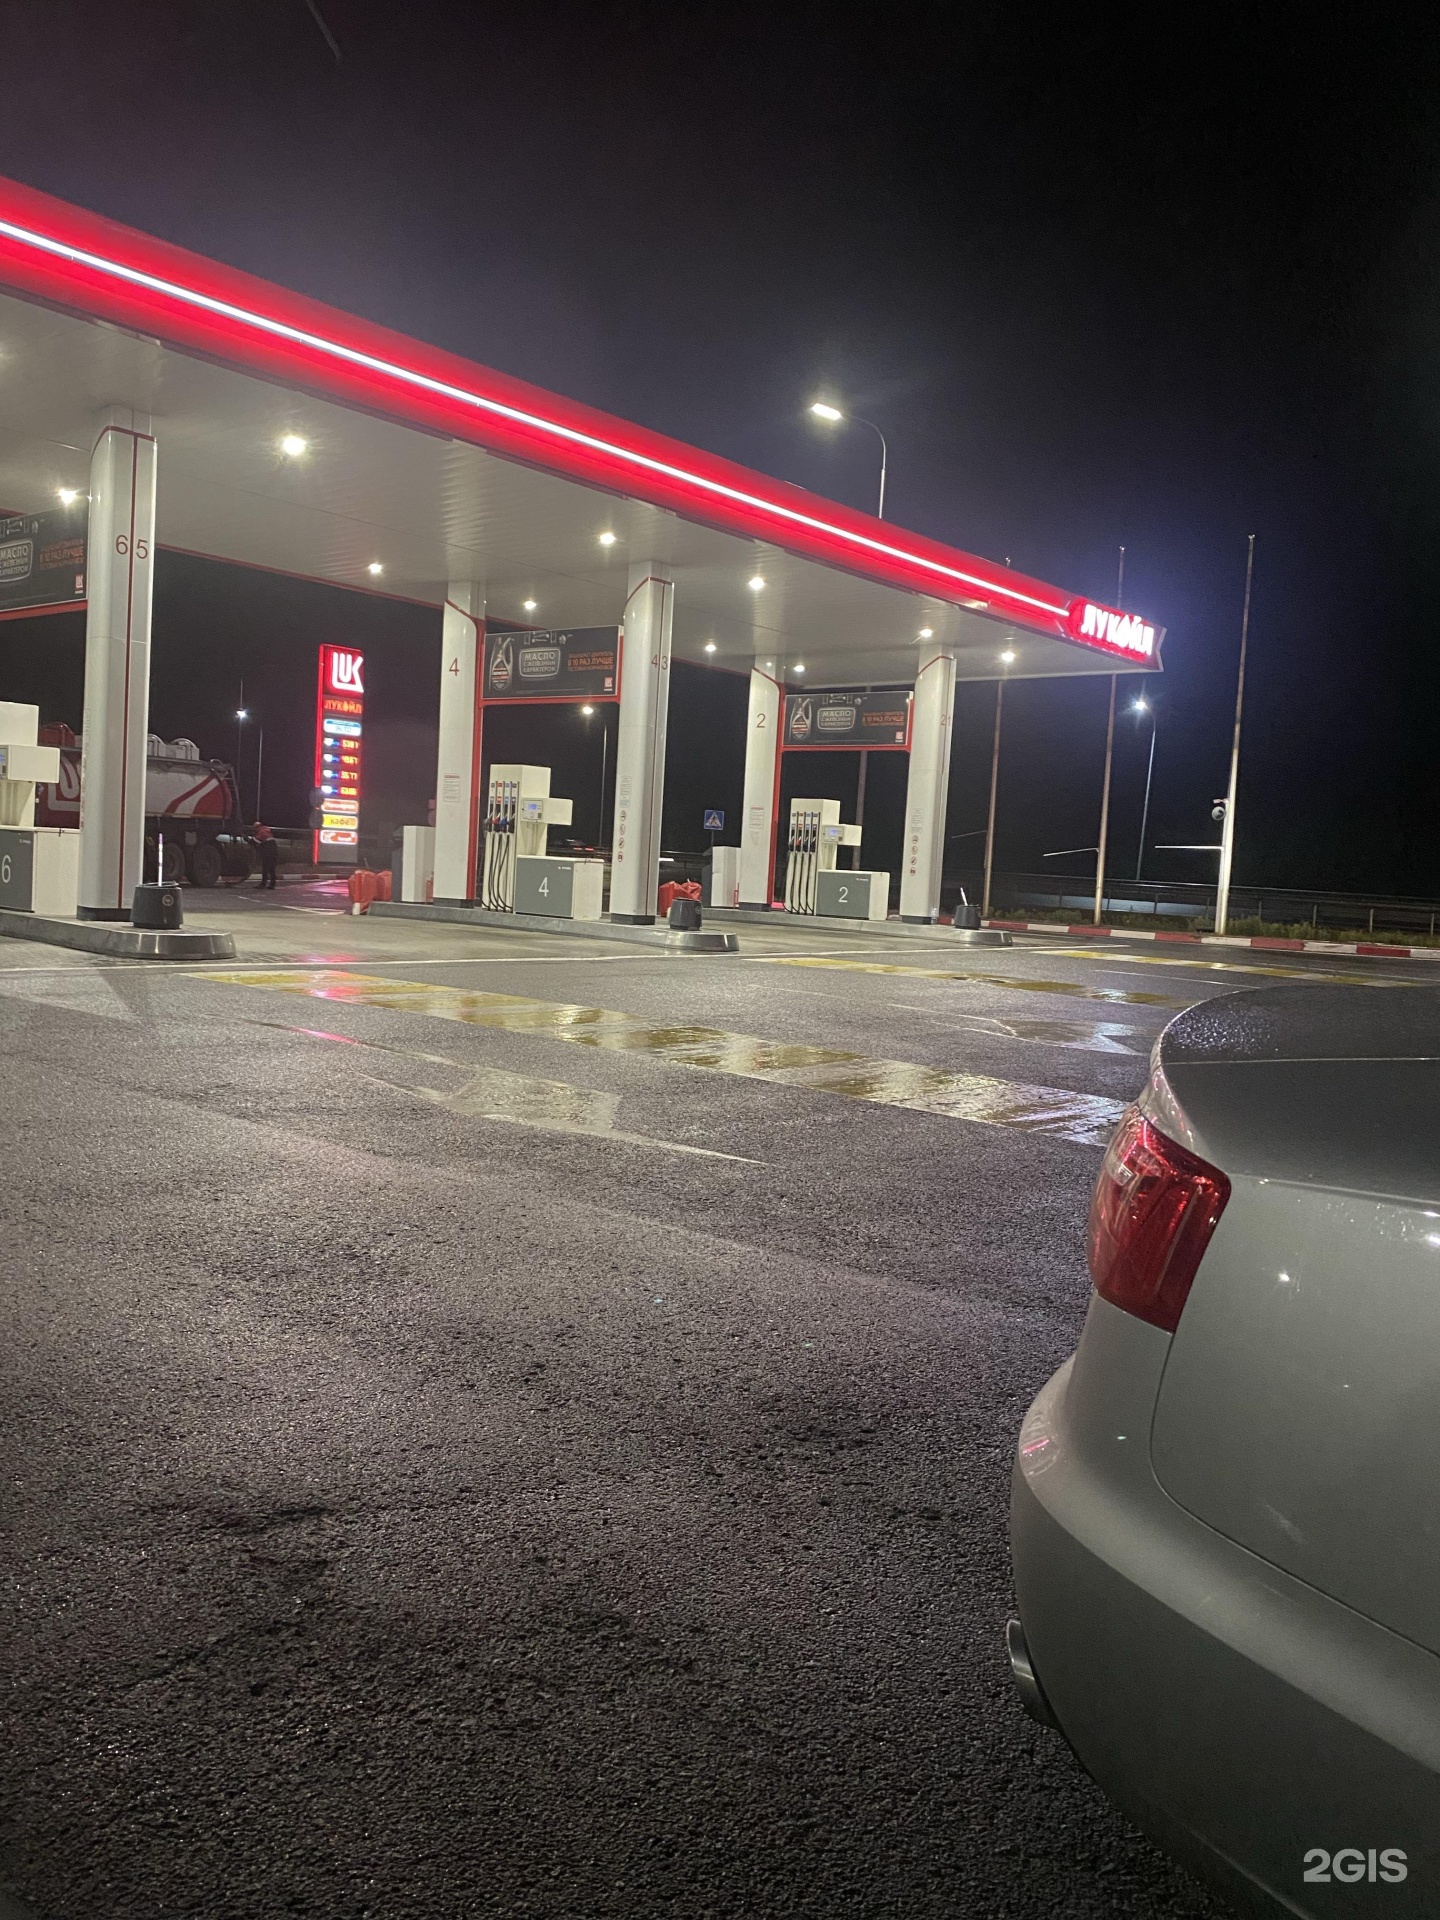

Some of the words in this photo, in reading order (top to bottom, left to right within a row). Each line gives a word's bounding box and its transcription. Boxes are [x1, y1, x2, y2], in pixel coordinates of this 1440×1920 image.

[0, 545, 29, 560] МАСЛО
[115, 534, 129, 555] 6
[136, 539, 148, 559] 5
[1081, 604, 1155, 656] ЛУКОЙЛ
[524, 652, 556, 661] МАСЛО
[579, 658, 590, 666] РАЗ
[651, 654, 658, 669] 4
[661, 655, 668, 670] 3
[449, 657, 460, 677] 4
[324, 699, 363, 714] ЛУКОЙЛ
[756, 713, 766, 729] 2
[940, 714, 946, 726] 2
[2, 854, 12, 883] 6
[538, 876, 549, 897] 4
[838, 886, 849, 903] 2
